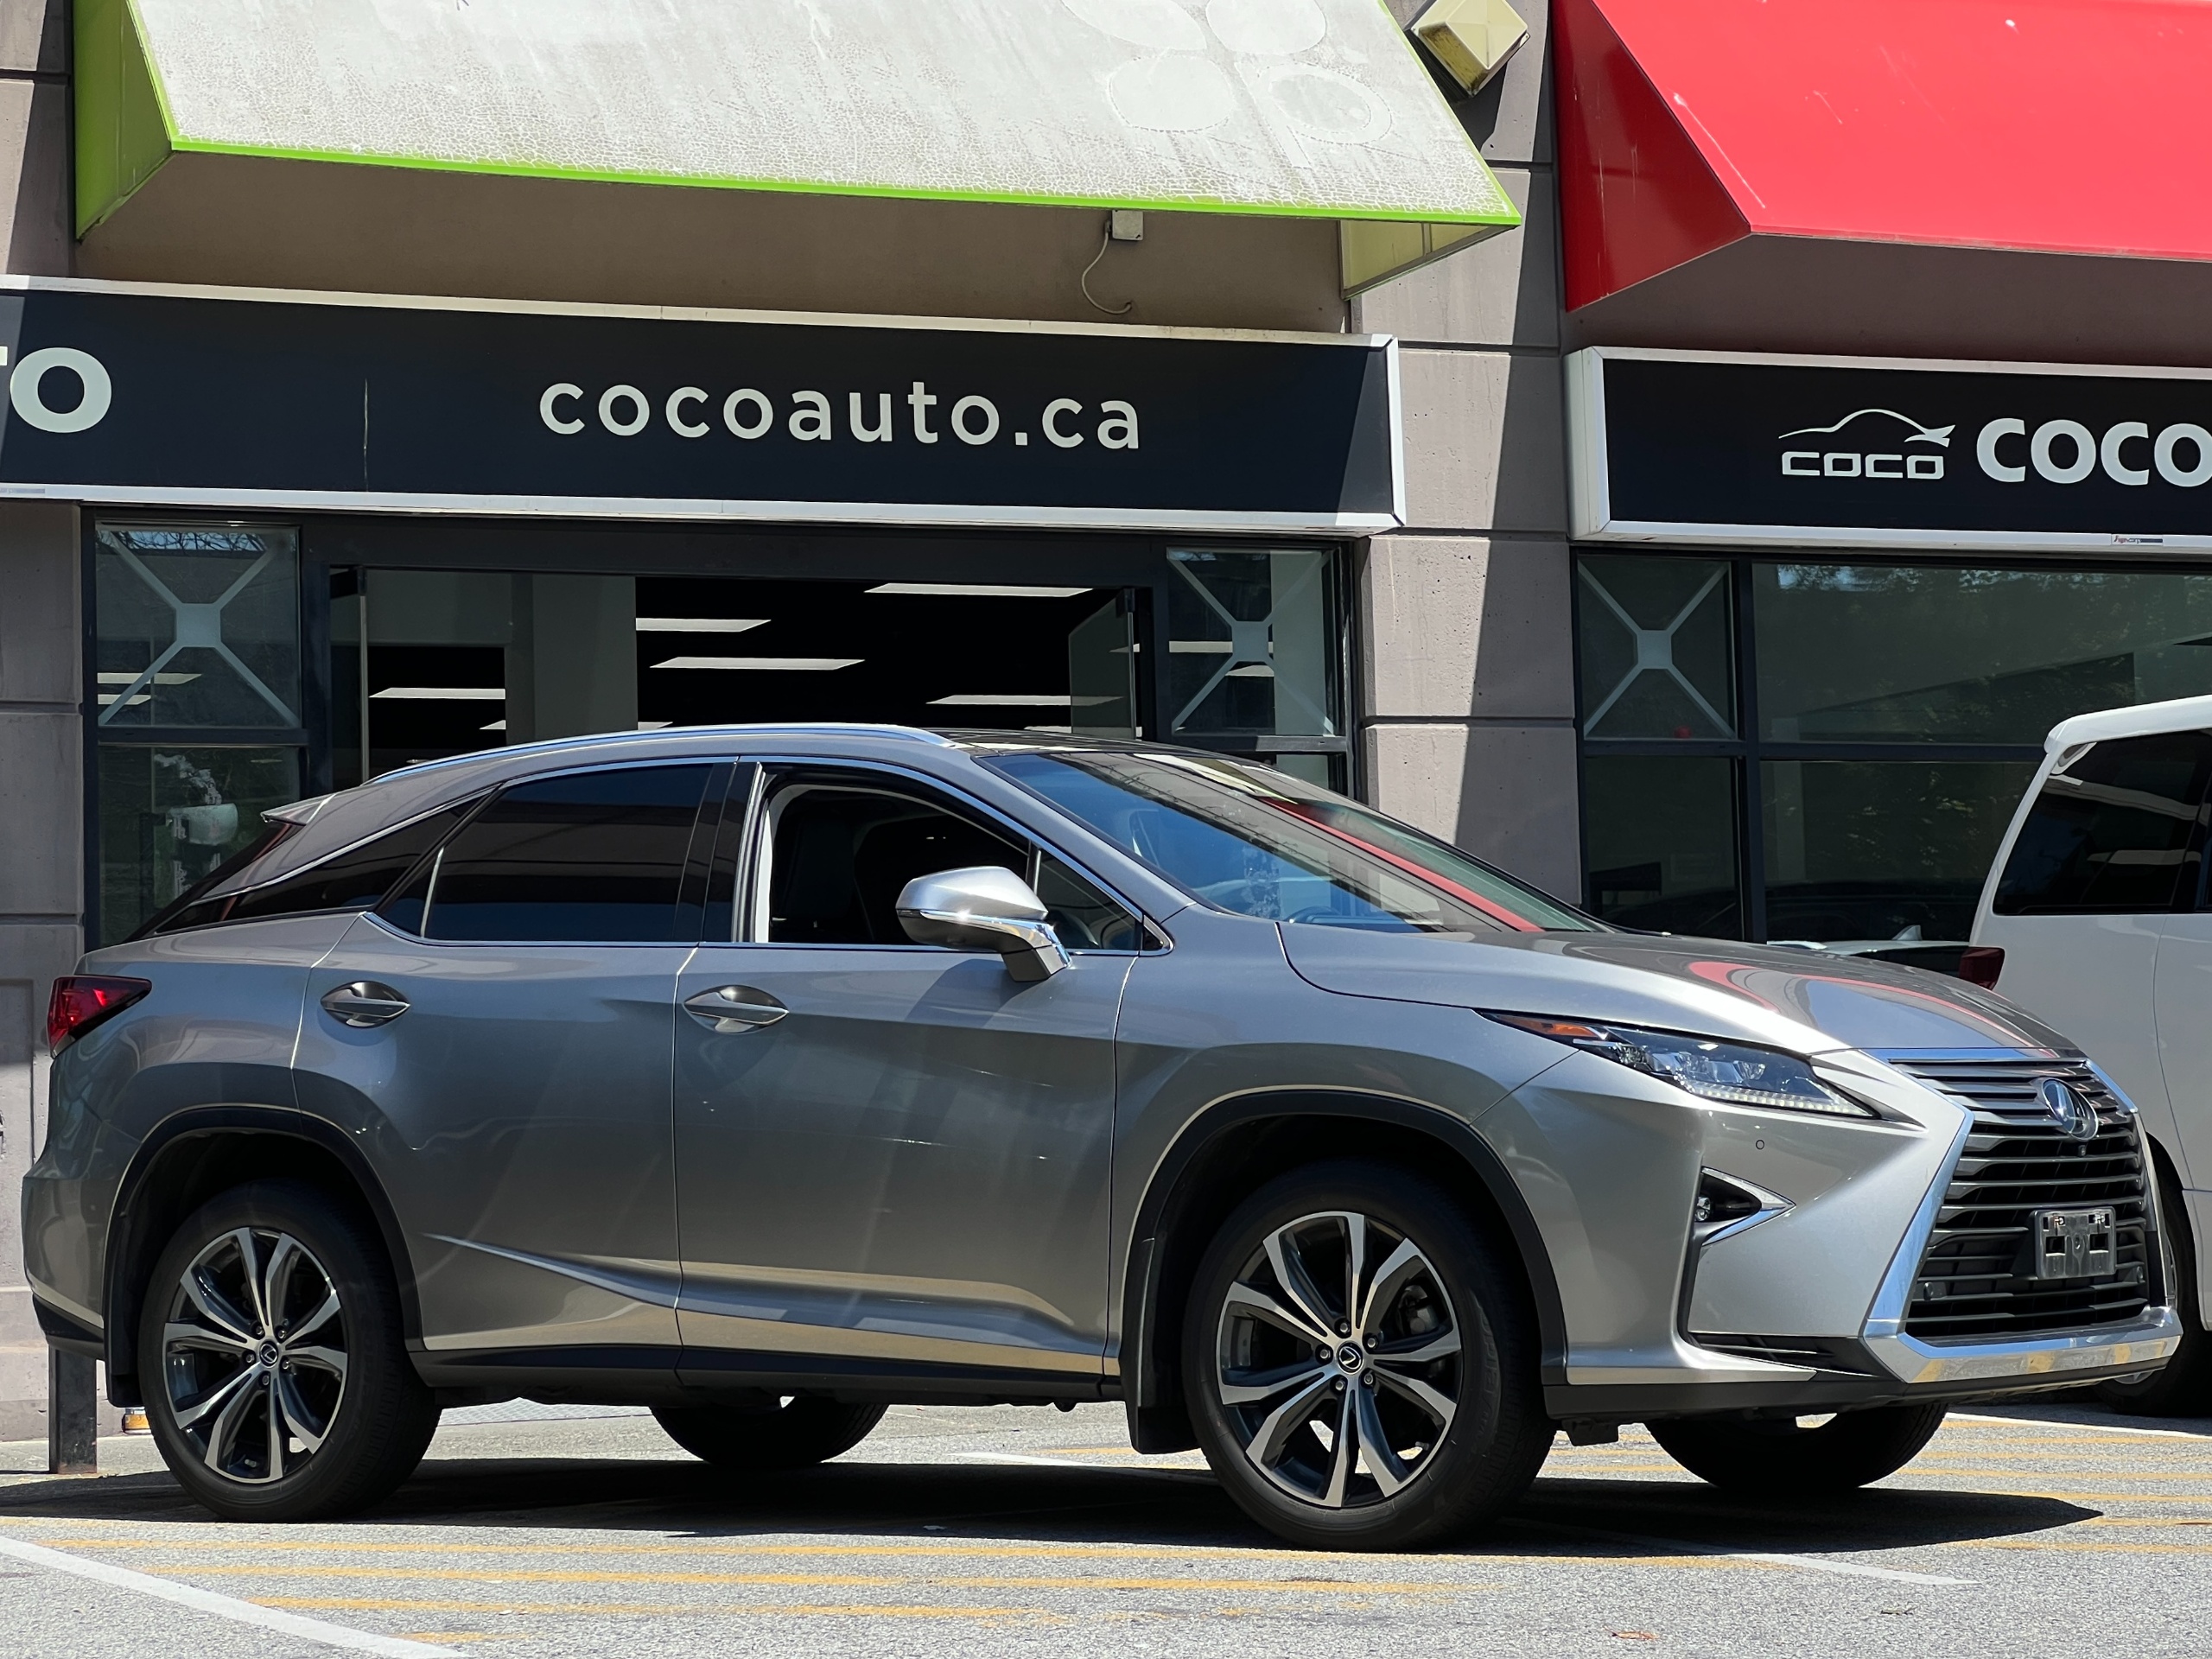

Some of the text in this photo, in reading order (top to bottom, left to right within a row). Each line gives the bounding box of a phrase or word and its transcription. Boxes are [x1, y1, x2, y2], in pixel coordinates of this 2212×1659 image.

[0, 346, 111, 433] O
[539, 382, 1139, 449] cocoauto.ca
[1782, 451, 1945, 480] COCO
[1976, 417, 2212, 487] COCO
